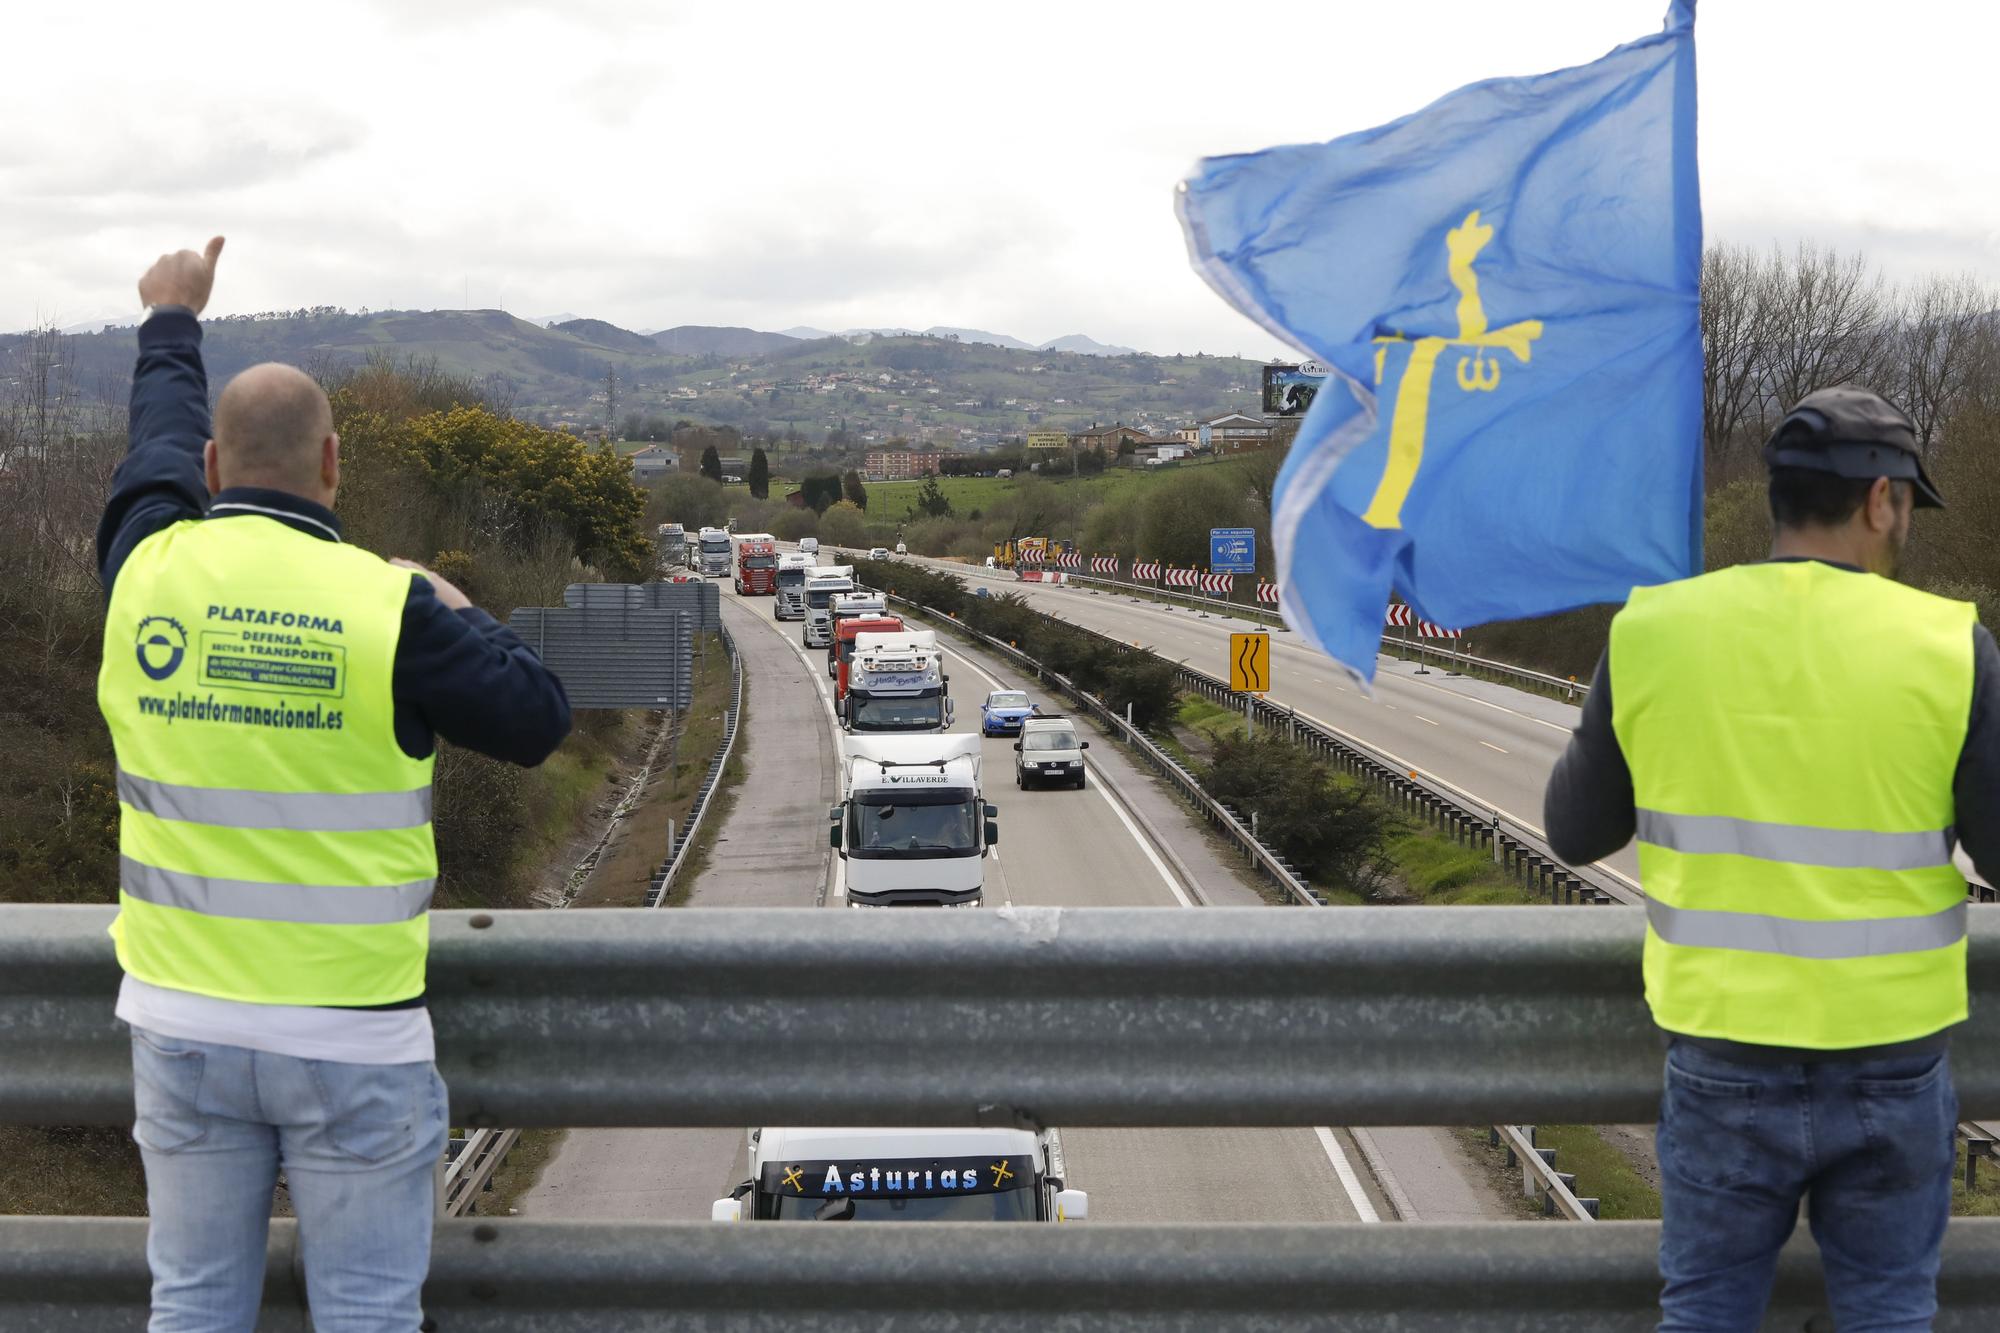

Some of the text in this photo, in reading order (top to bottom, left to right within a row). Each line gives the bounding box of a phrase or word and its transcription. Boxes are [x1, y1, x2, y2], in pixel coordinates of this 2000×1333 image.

[207, 605, 343, 634] PLATAFORMA
[242, 630, 302, 645] DEFENSA
[212, 643, 333, 662] SECTOR TRANSPORTE
[138, 692, 343, 730] www.plataformanacional.es
[822, 1164, 978, 1193] Asturias
